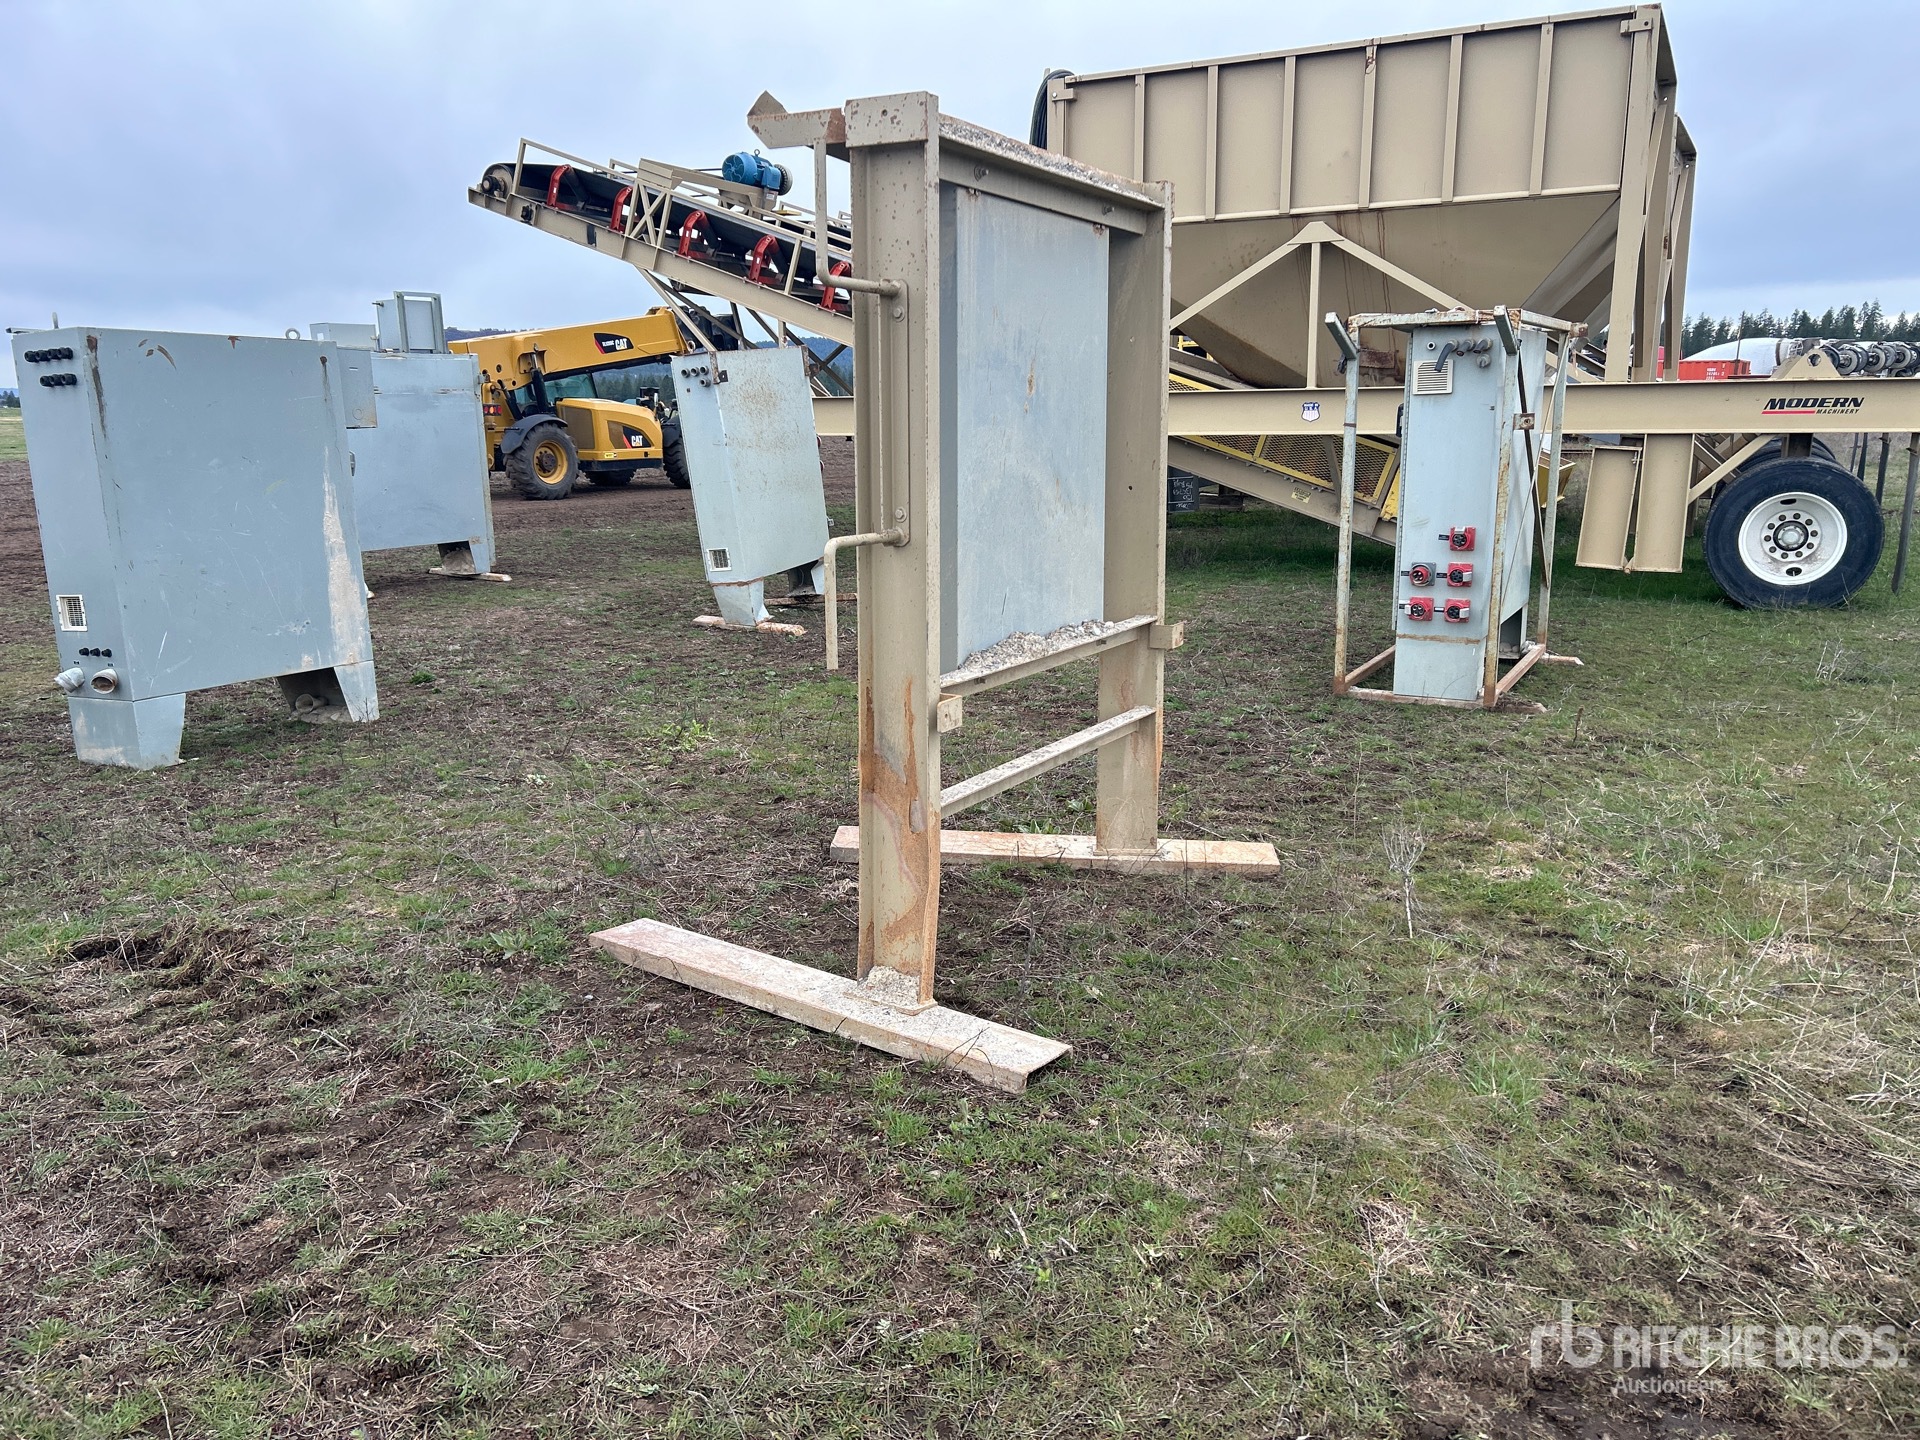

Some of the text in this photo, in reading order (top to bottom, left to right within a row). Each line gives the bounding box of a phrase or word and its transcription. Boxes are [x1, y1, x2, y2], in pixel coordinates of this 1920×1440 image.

[615, 338, 627, 350] CAT
[1764, 397, 1865, 410] MODERN
[631, 435, 643, 447] CAT
